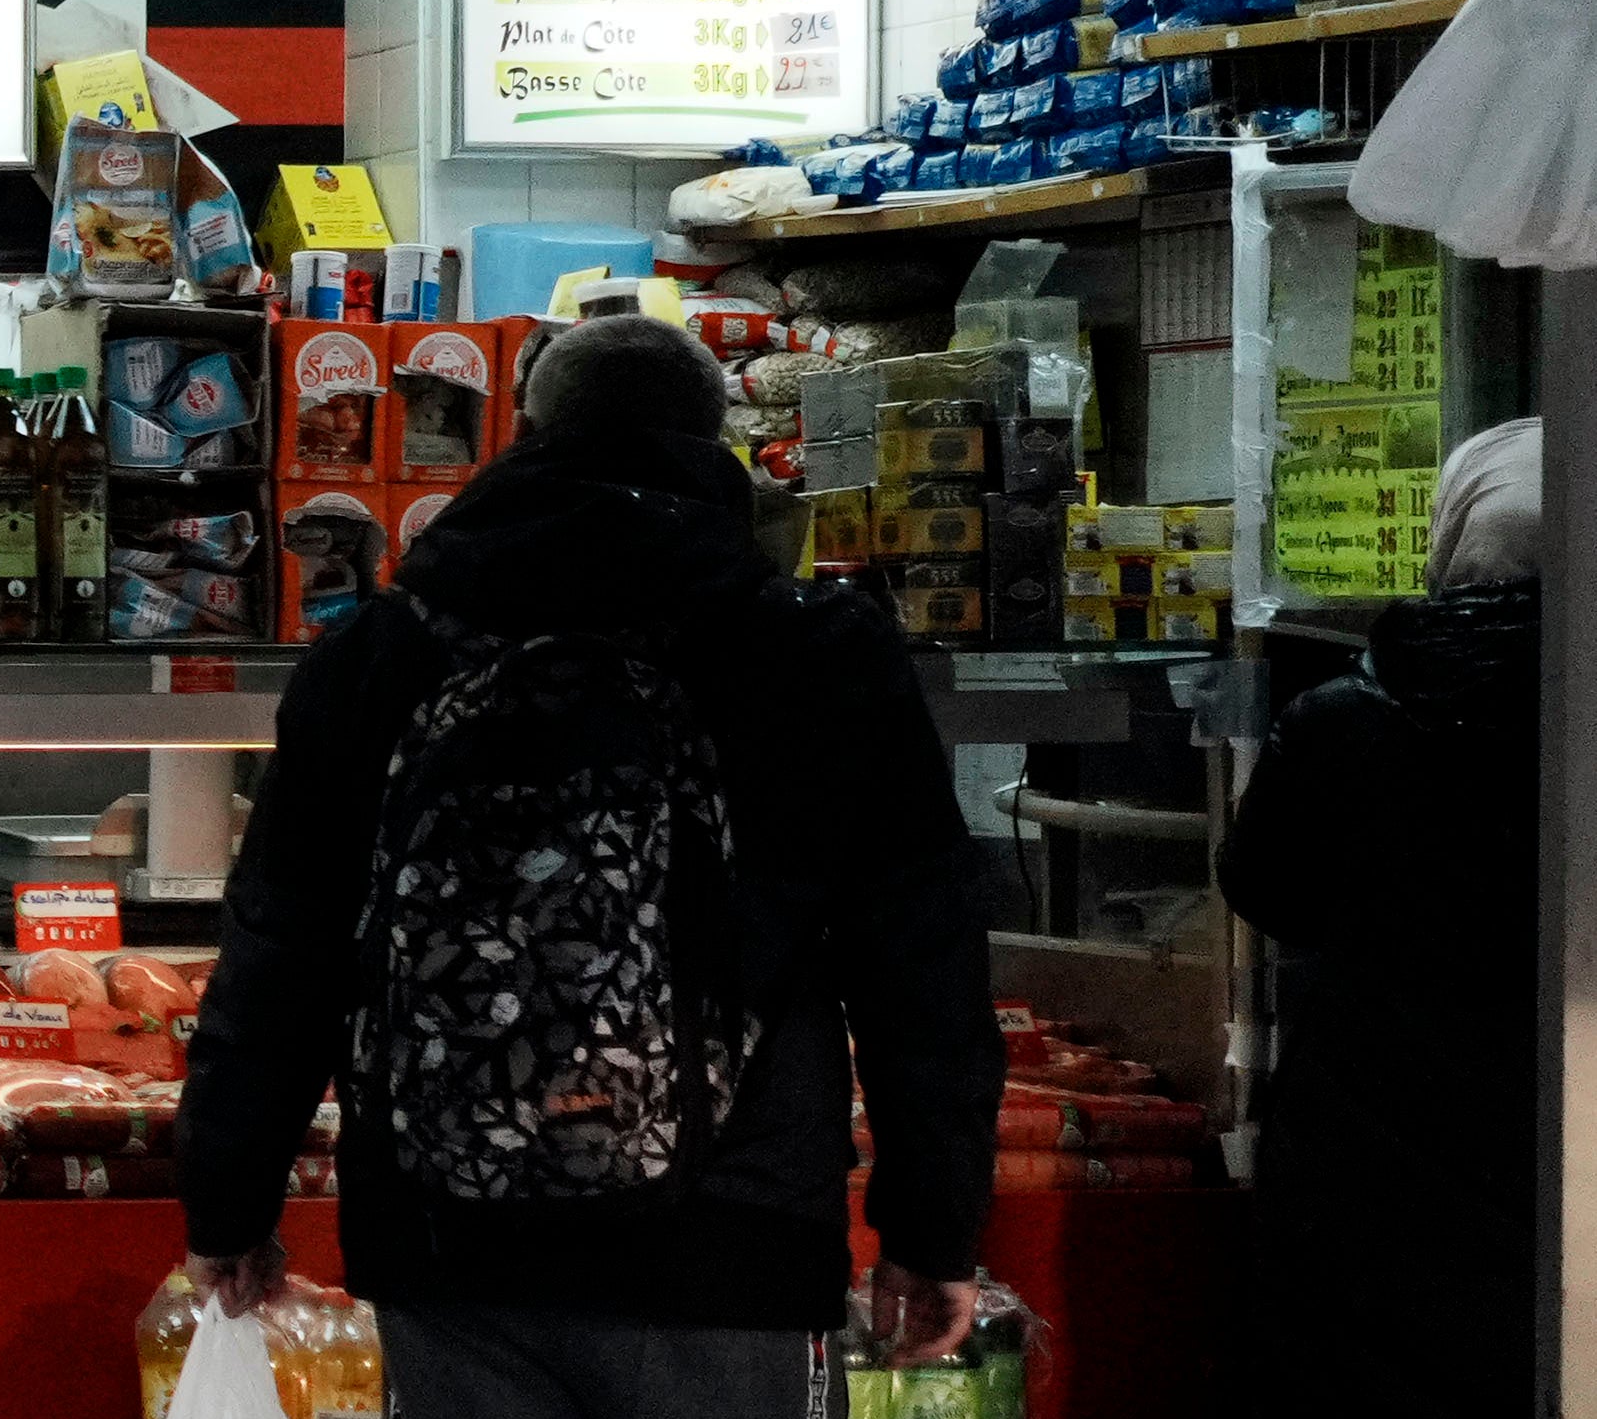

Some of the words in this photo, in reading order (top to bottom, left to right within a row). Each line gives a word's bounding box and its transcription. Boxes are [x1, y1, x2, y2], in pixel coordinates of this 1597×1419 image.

[498, 19, 554, 53] Plat
[694, 18, 748, 52] 3Kg
[498, 66, 584, 101] Basse
[694, 65, 748, 99] 3Kg
[301, 354, 370, 387] Sweet
